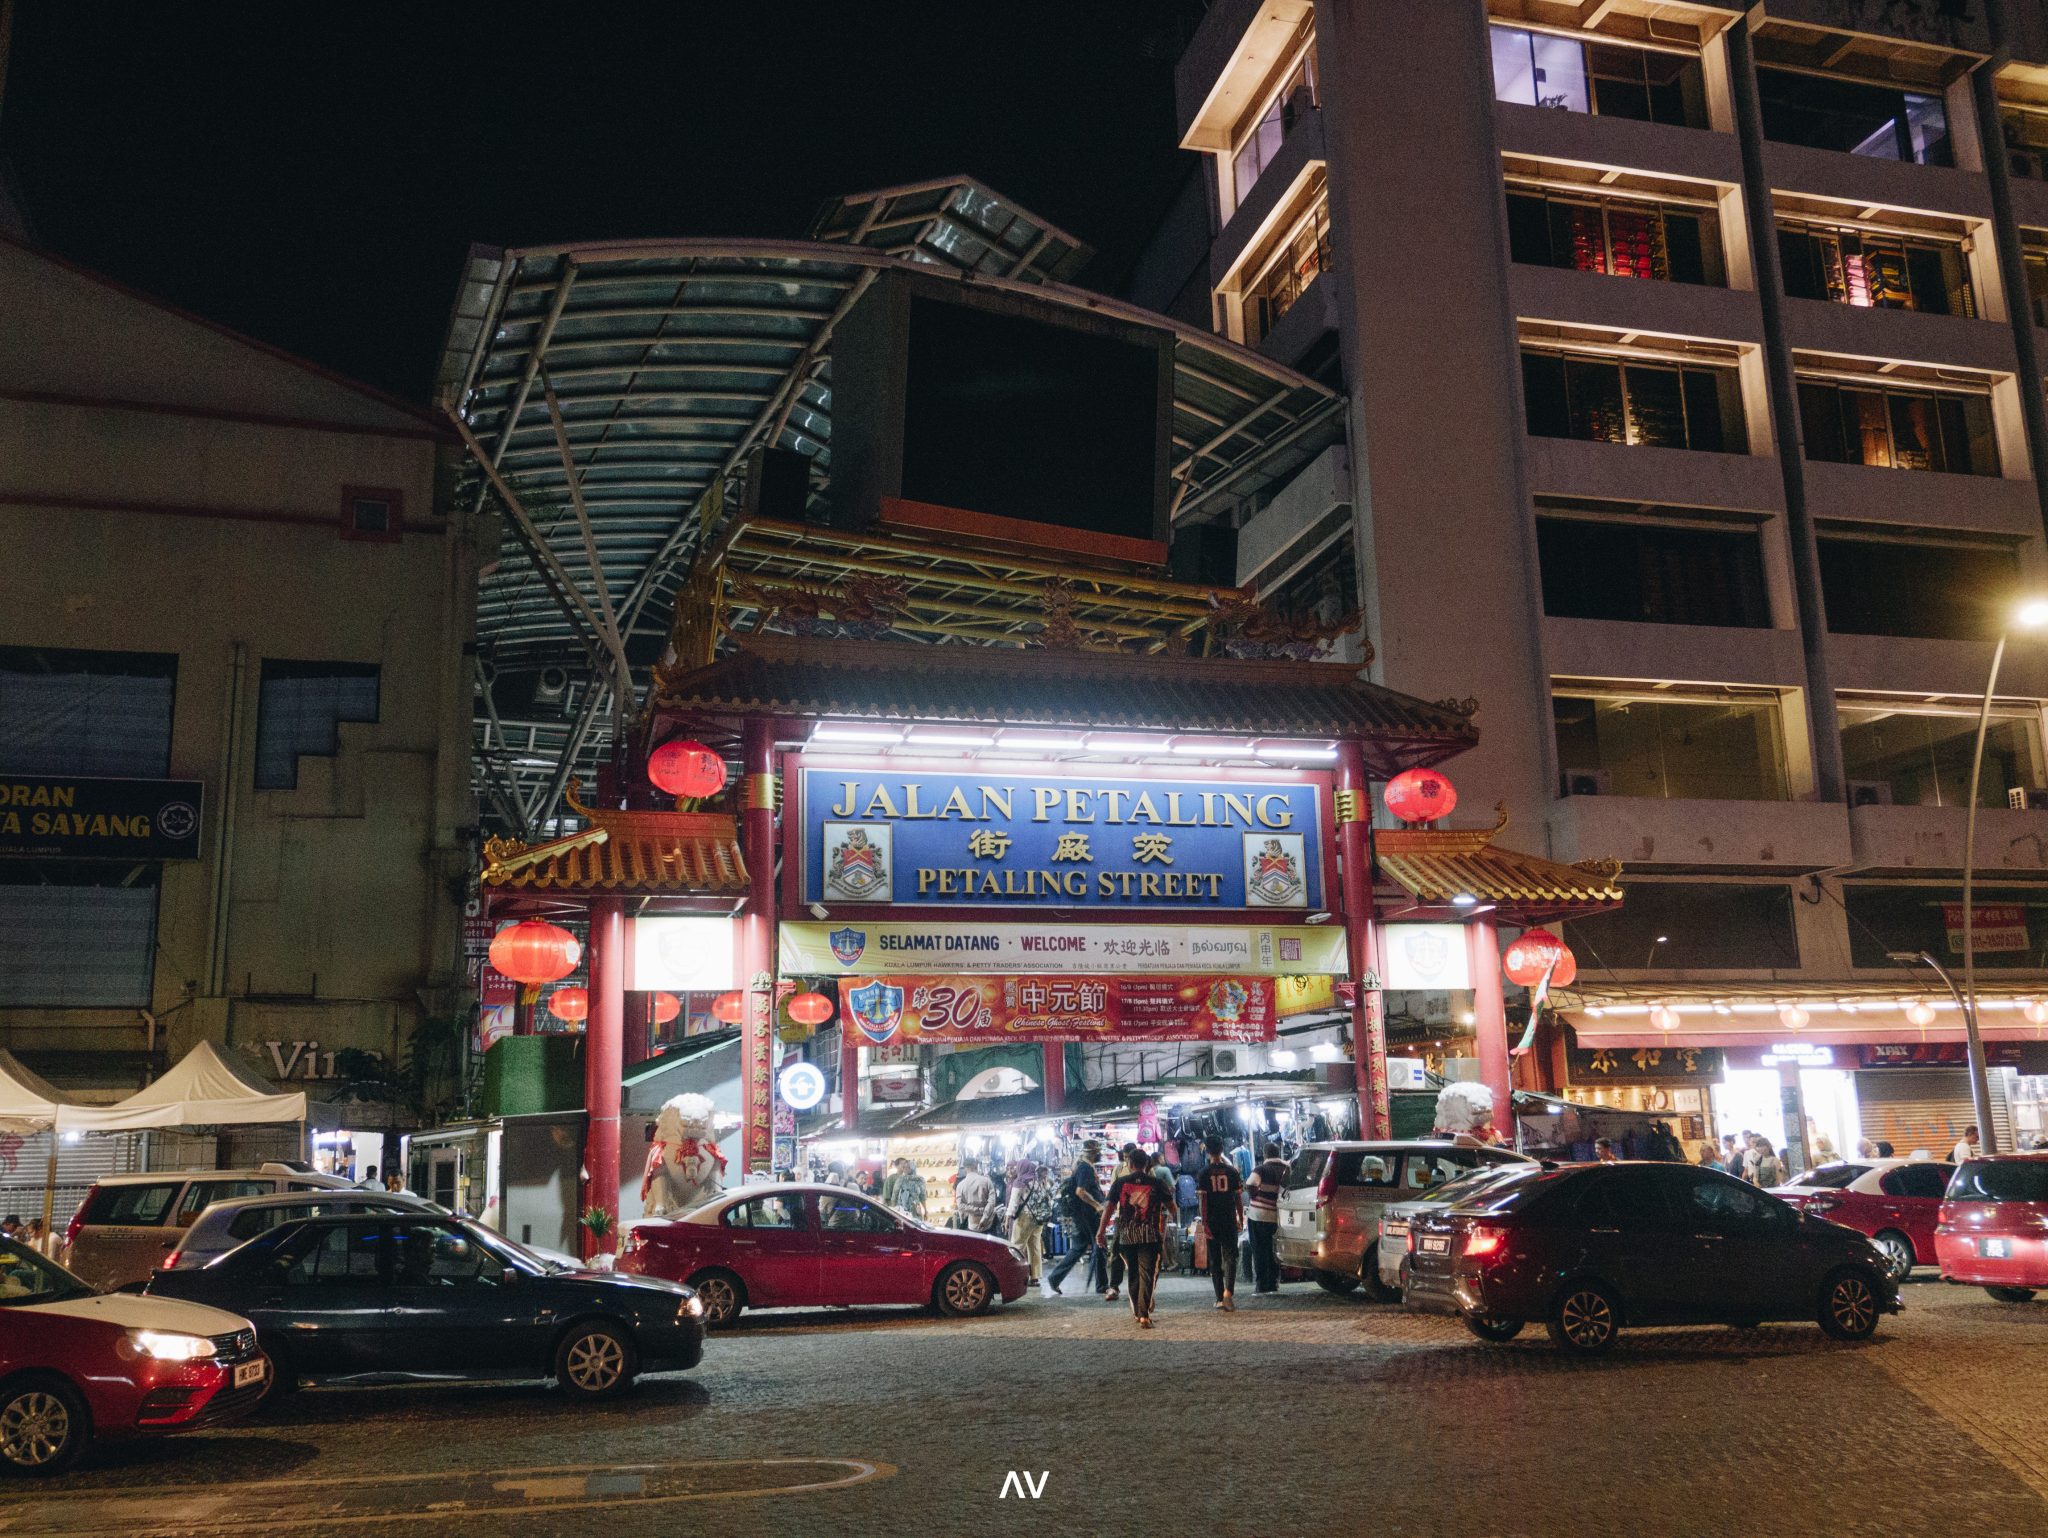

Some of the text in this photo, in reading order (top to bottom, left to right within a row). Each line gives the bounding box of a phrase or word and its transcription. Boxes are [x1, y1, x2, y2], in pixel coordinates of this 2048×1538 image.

[832, 781, 1294, 829] JALAN PETALING
[32, 812, 150, 838] SAYANG
[916, 868, 1087, 896] PETALING
[1098, 871, 1224, 898] STREET
[879, 934, 942, 951] SELAMAT
[945, 934, 1000, 951] DATANG
[1020, 936, 1086, 952] WELCOME
[1103, 939, 1171, 957] 欢迎光临
[1021, 982, 1106, 1013] 中元節
[1013, 1016, 1106, 1030] Chinese Ghost Festival
[1210, 1174, 1229, 1193] 10
